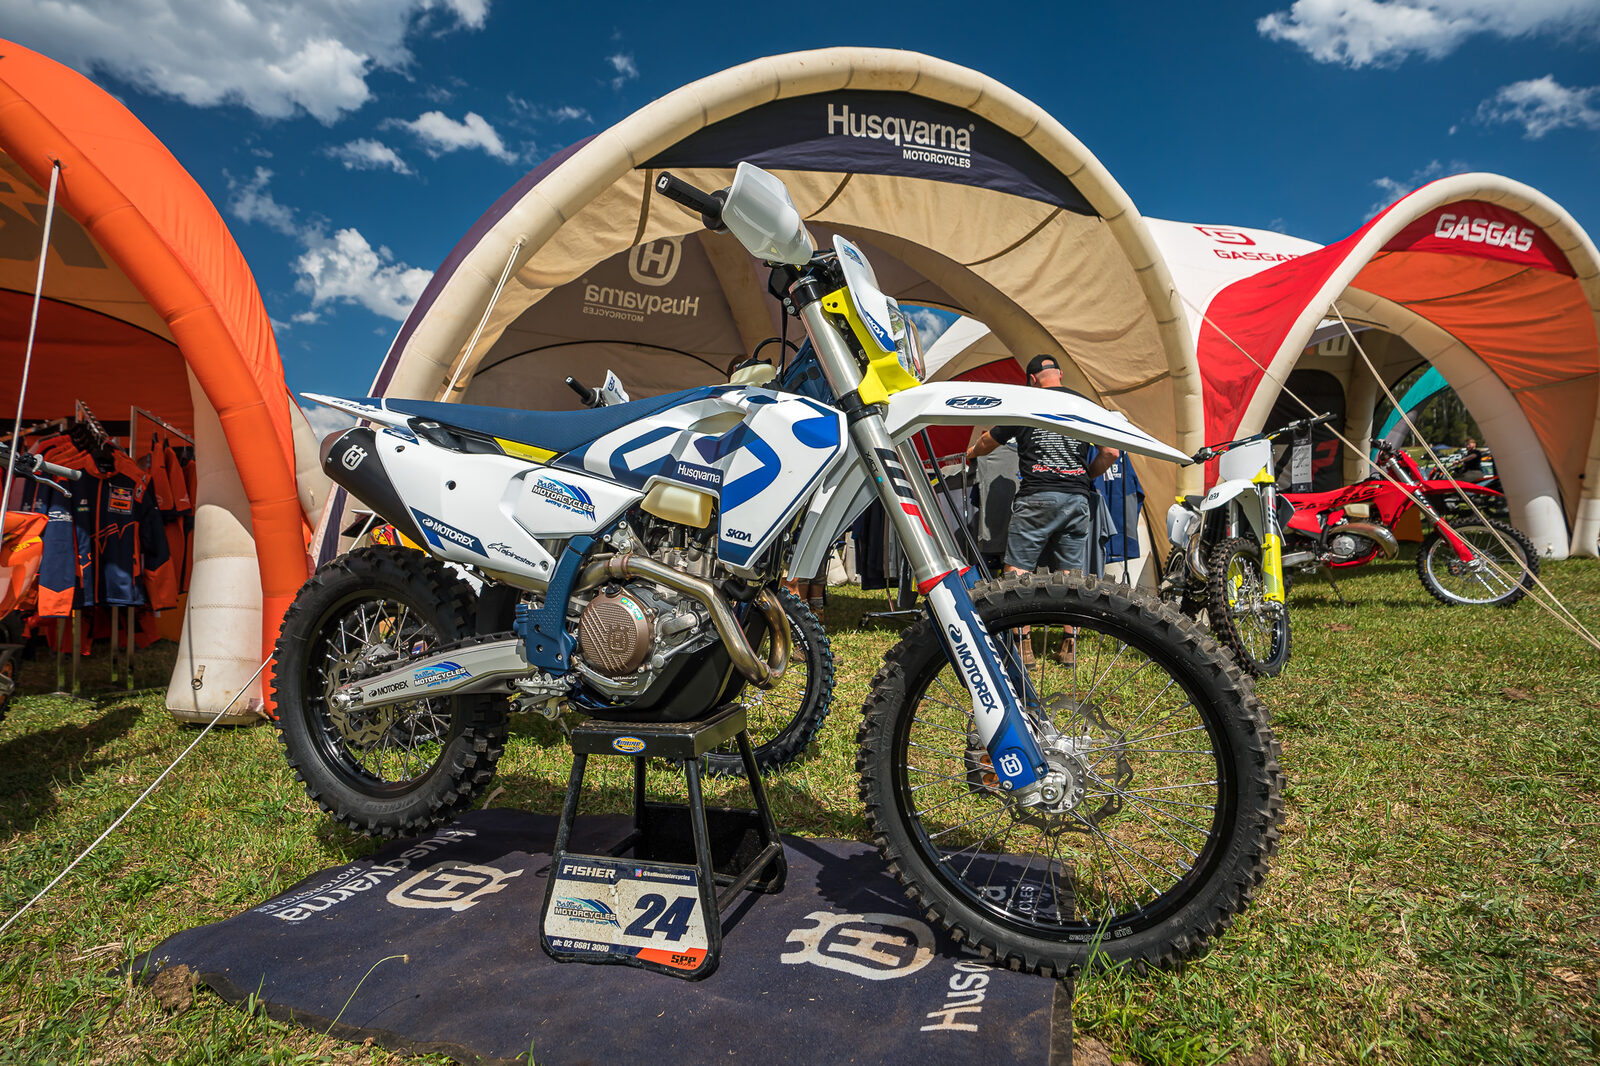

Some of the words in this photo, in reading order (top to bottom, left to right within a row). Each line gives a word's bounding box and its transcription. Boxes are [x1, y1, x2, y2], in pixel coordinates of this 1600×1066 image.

[827, 103, 971, 152] Husqvarna
[902, 149, 971, 169] MOTORCYCLES
[1434, 213, 1534, 252] GASGAS
[945, 397, 1003, 406] FMF
[677, 463, 720, 484] Husqvarna
[531, 485, 595, 513] MOTORCYCLES
[432, 521, 475, 548] MOTOREX
[725, 528, 752, 543] SKDA
[500, 548, 537, 568] alpinestars
[413, 666, 467, 687] MOTORCYCLES
[955, 642, 999, 715] MOTOREX
[377, 680, 409, 697] MOTOREX
[272, 827, 477, 921] Husqvarna
[562, 864, 617, 879] FISHER
[554, 907, 617, 921] MOTORCYCLES
[623, 893, 697, 942] 24
[563, 940, 573, 948] 02
[573, 941, 591, 950] 6681
[671, 955, 697, 963] SPP
